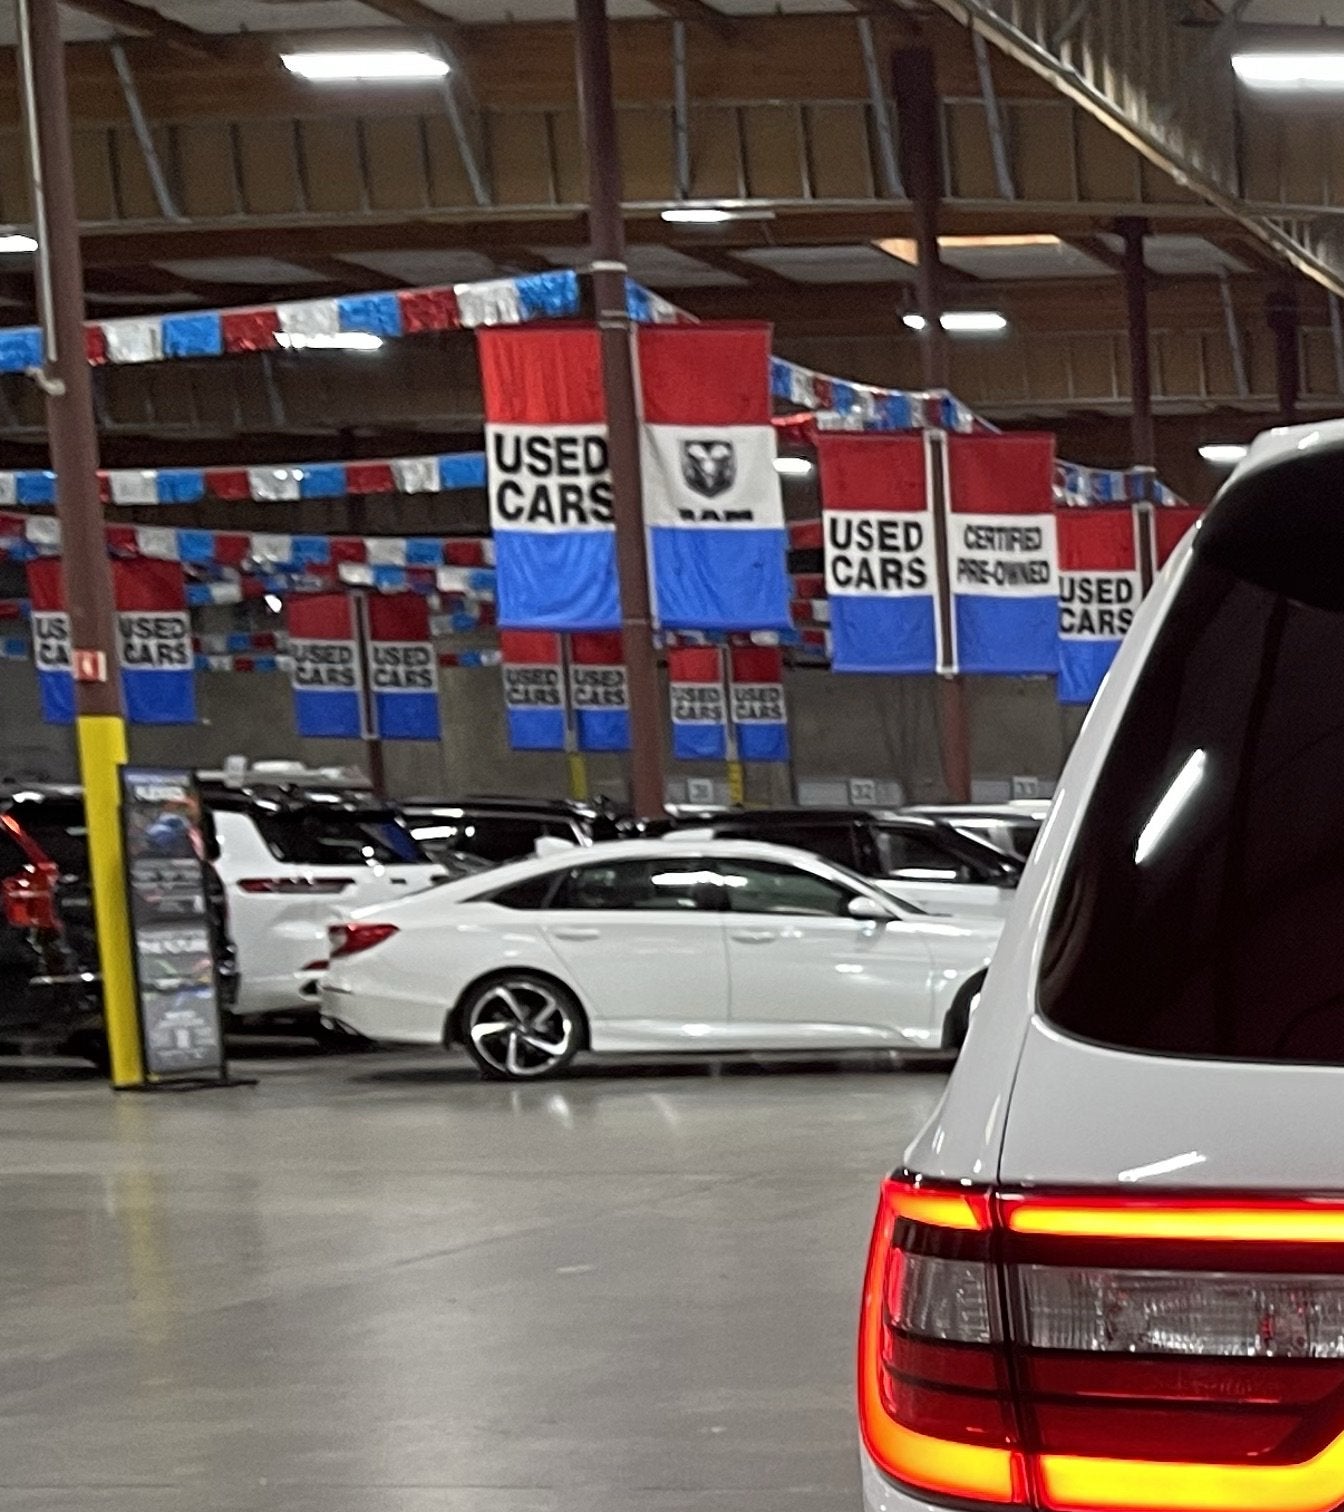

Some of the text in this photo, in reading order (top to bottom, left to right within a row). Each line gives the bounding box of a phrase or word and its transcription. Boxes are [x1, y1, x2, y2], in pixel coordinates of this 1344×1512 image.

[494, 433, 609, 477] USED
[499, 480, 615, 524] CARS
[829, 518, 924, 552] USED
[963, 524, 1043, 551] CERTIFIED
[831, 555, 928, 591] CARS
[956, 557, 1050, 586] PRE-OWNED
[1059, 576, 1133, 604] USED
[35, 617, 69, 640] US
[119, 617, 185, 639] USED
[1060, 606, 1133, 635] CARS
[124, 643, 188, 665] CARS
[374, 646, 431, 667] USED
[375, 668, 433, 688] CARS
